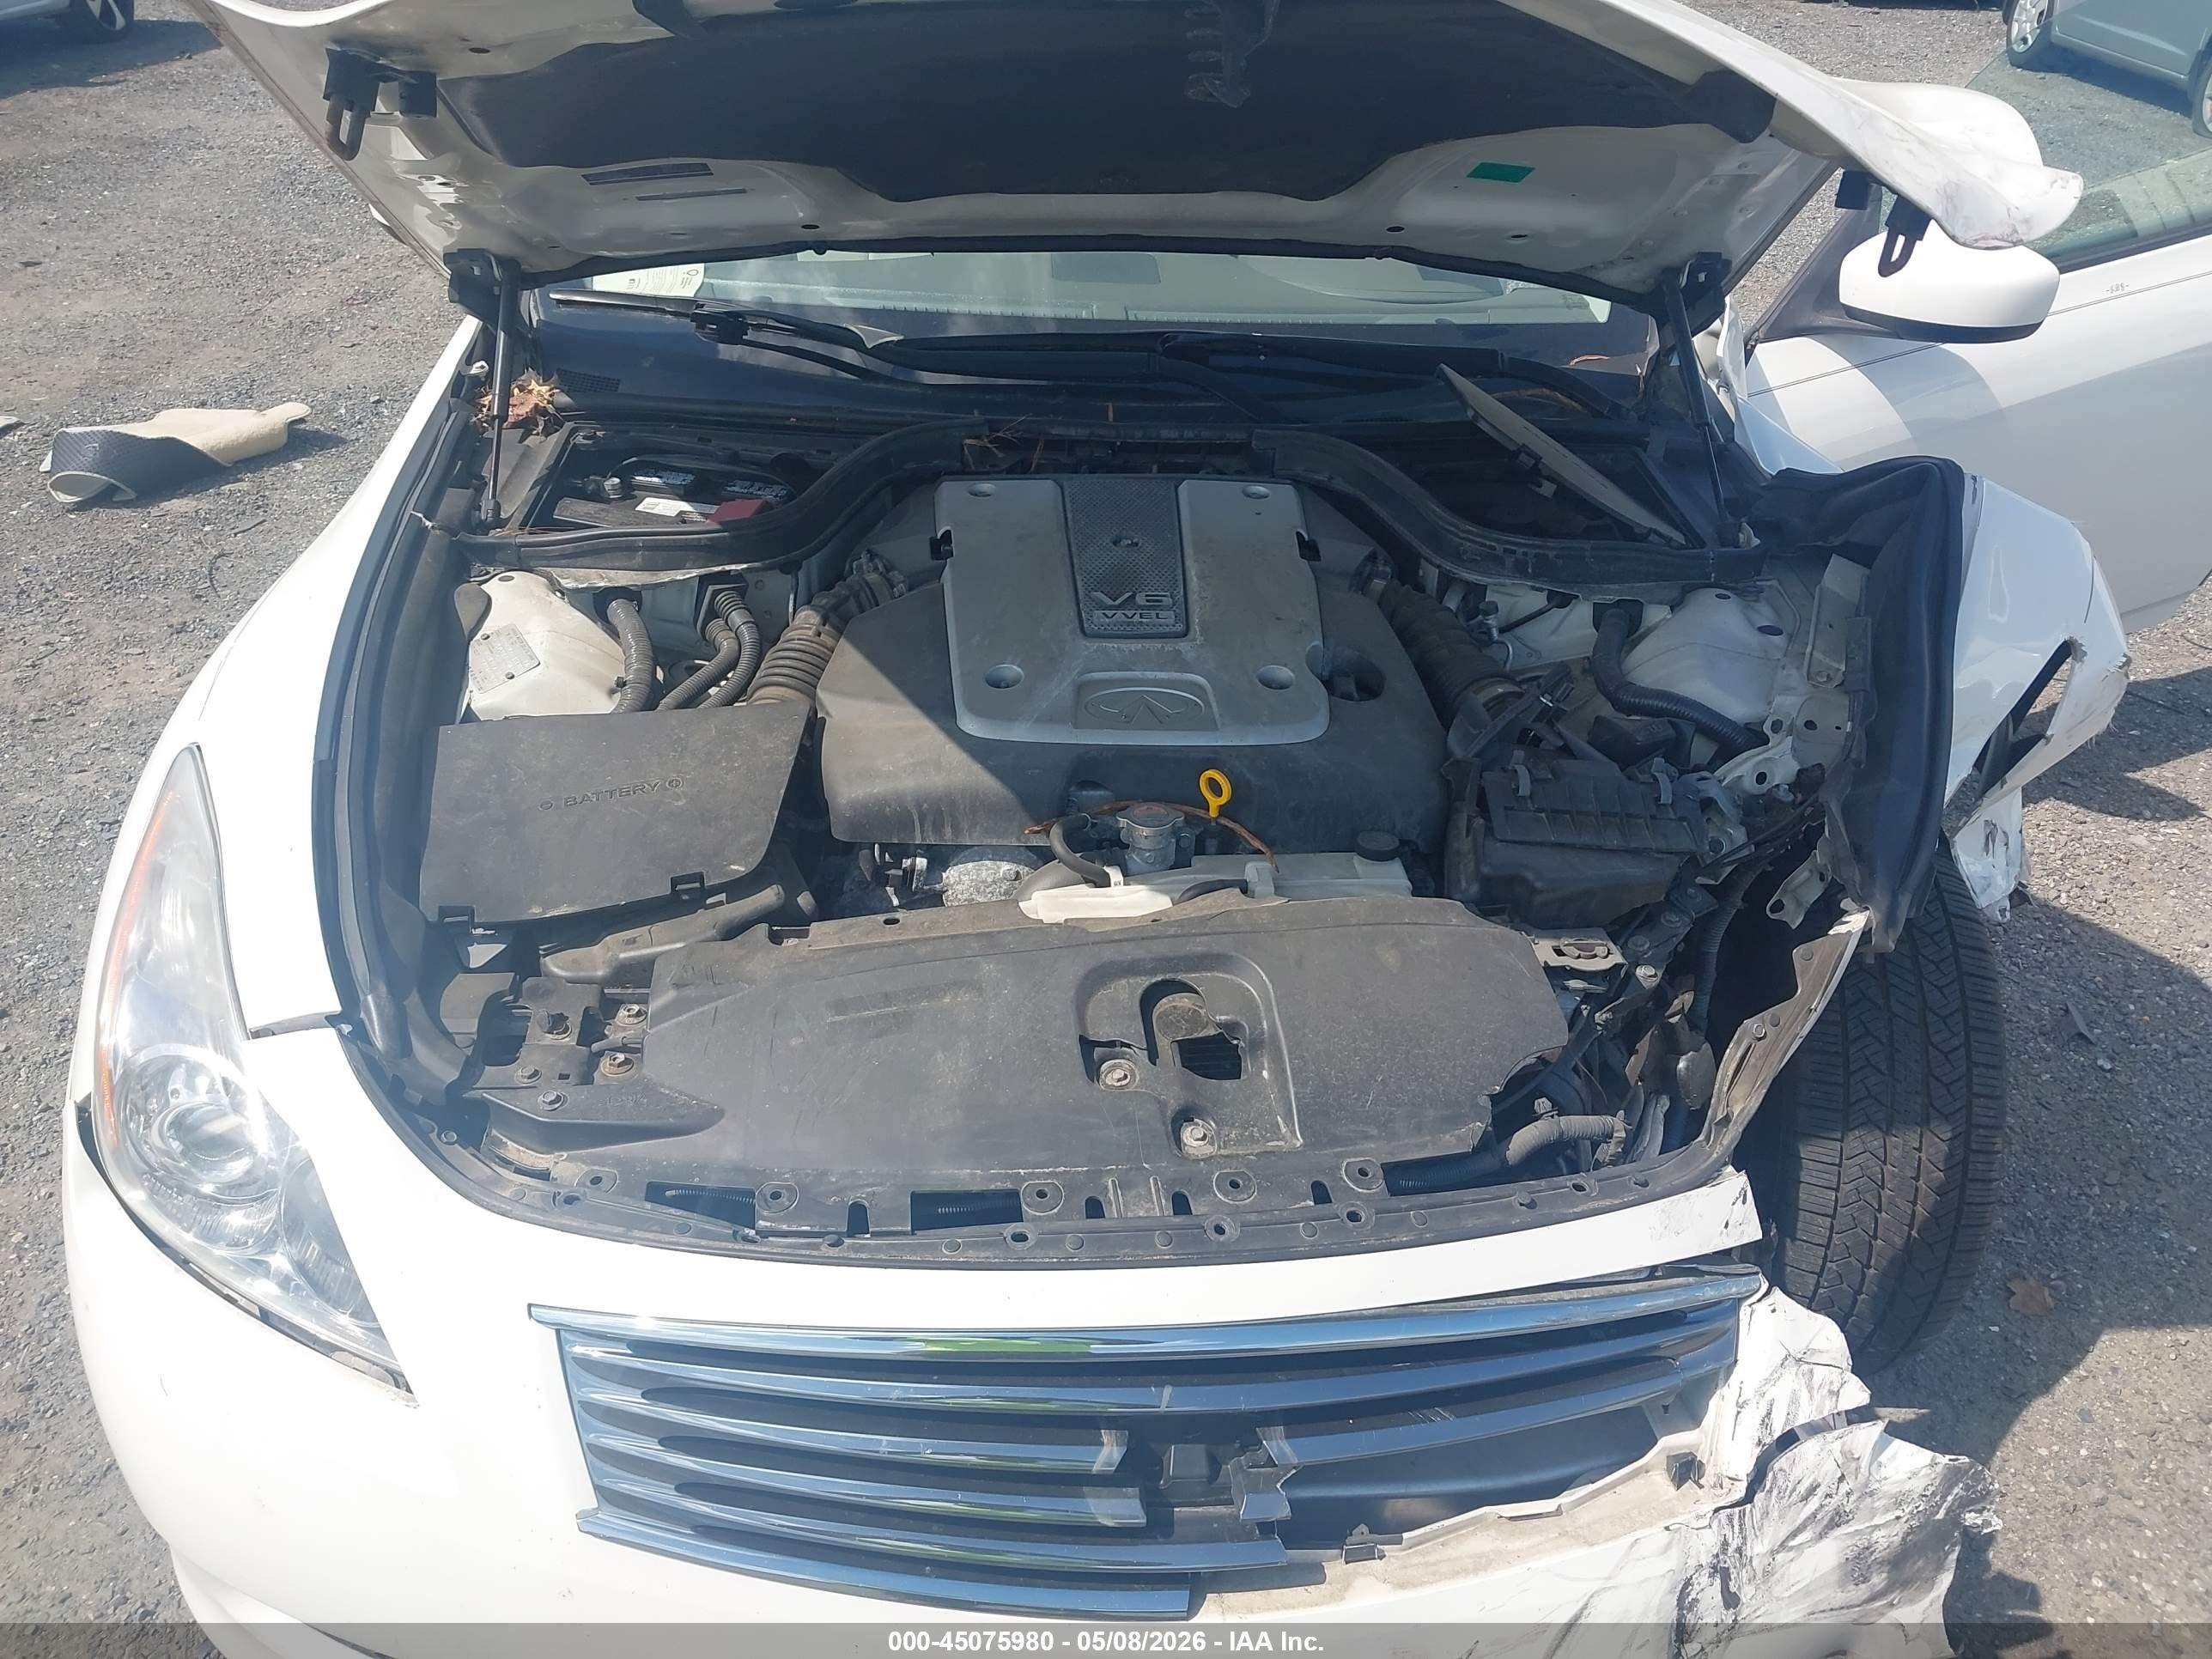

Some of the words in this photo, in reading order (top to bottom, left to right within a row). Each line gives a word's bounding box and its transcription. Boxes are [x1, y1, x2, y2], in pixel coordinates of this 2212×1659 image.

[1090, 591, 1173, 607] V6
[1101, 611, 1170, 620] VVEL
[563, 781, 660, 807] BATTERY
